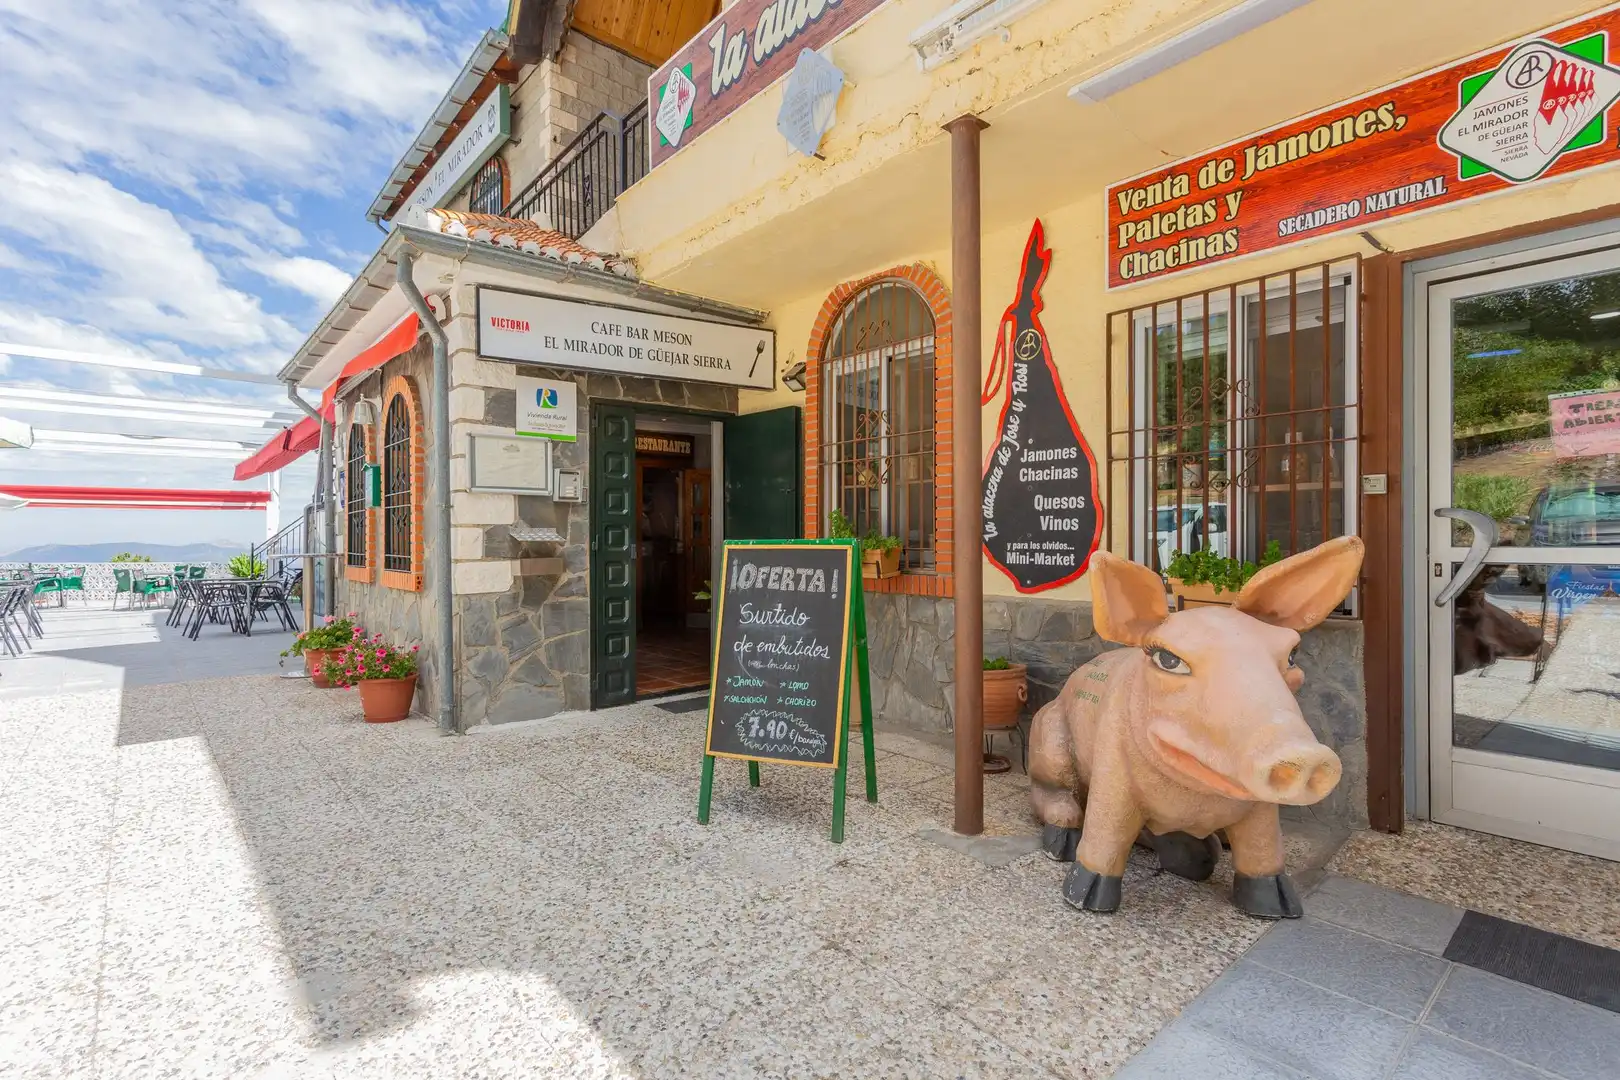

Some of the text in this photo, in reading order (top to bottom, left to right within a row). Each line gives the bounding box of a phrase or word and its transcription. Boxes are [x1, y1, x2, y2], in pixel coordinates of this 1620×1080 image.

[1473, 96, 1529, 120] JAMONES
[1458, 109, 1529, 137] EL MIRADOR
[1478, 121, 1529, 142] DE GÜEJAR
[448, 124, 483, 172] MIRADOR
[1495, 132, 1529, 147] SIERRA
[1117, 101, 1408, 216] Venta de Jamones,
[1500, 151, 1529, 164] NEVADA
[1504, 145, 1529, 156] SIERRA
[1278, 176, 1447, 238] SECADERO NATURAL
[1118, 189, 1243, 249] Paletas y
[1118, 227, 1239, 281] Chacinas
[491, 316, 530, 332] VICTORIA
[591, 321, 693, 346] CAFE BAR MESON
[544, 335, 732, 371] EL MIRADOR DE GÜEJAR SIERRA
[1012, 362, 1028, 395] Rosi
[1012, 398, 1027, 412] y
[997, 446, 1012, 466] de
[1020, 446, 1077, 463] Jamones
[1019, 466, 1078, 482] Chacinas
[982, 466, 1004, 519] alacena
[1034, 494, 1085, 511] Quesos
[1040, 515, 1079, 531] Vinos
[1007, 540, 1075, 551] y para los olvidos...
[1006, 551, 1075, 566] Mini-Market
[1566, 580, 1606, 591] Fiestas
[739, 602, 811, 627] Surtido
[733, 634, 831, 660] de embutidos
[788, 681, 810, 691] LOMO
